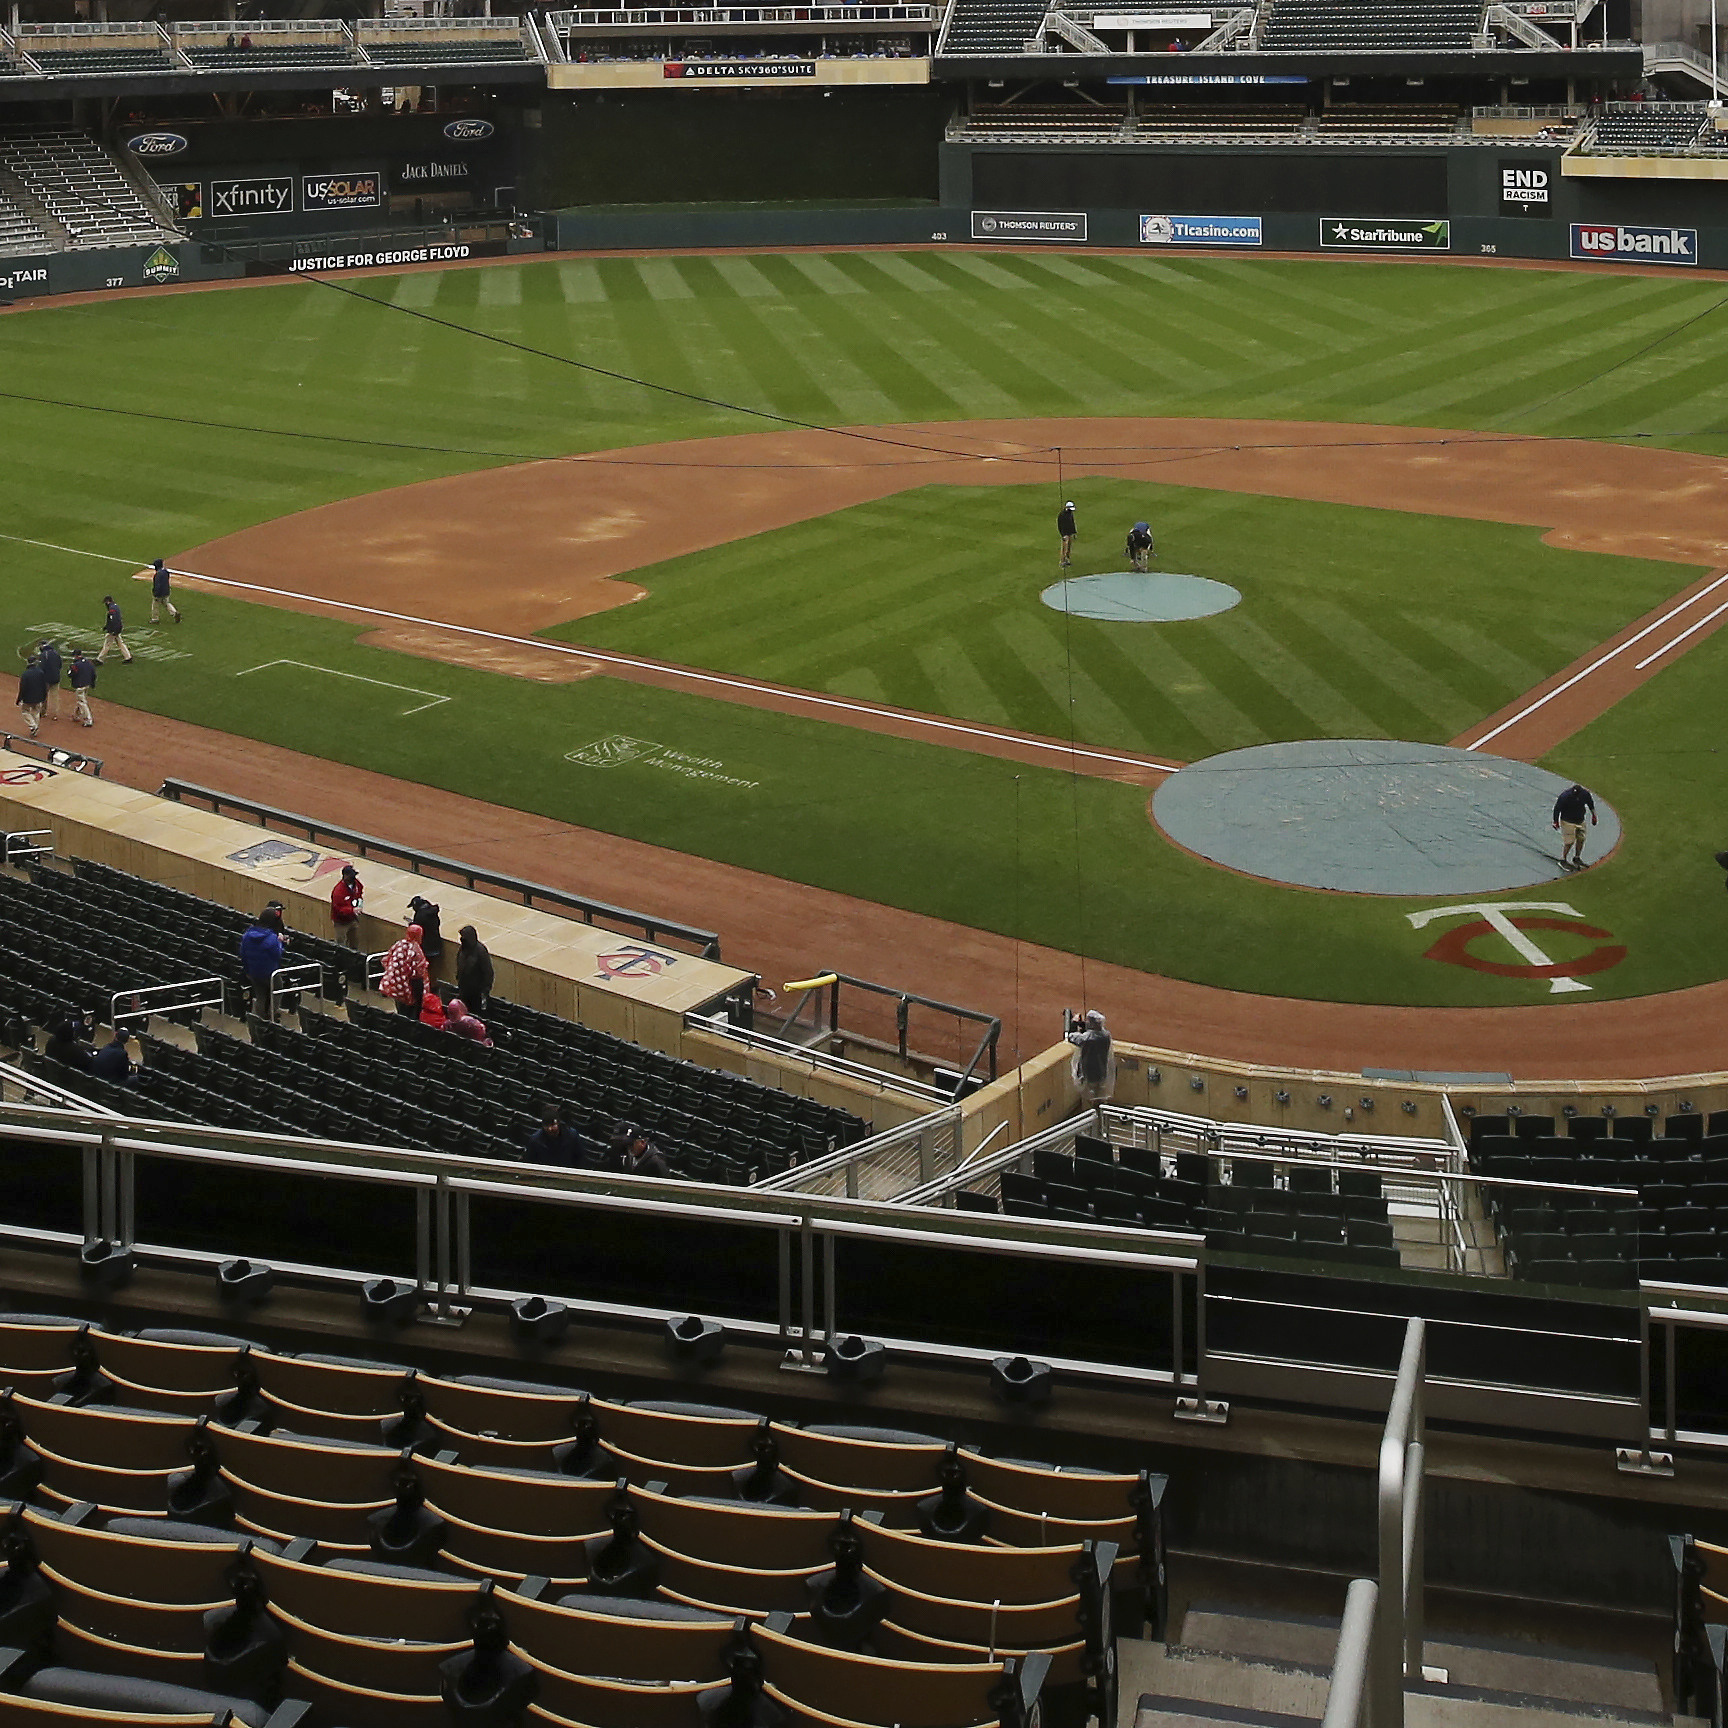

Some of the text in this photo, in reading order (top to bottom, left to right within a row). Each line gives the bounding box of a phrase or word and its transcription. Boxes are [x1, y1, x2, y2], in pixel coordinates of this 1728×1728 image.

[697, 65, 735, 76] DELTA
[1146, 75, 1265, 84] TREASURE ISLAND COVE
[453, 122, 485, 138] Ford
[139, 134, 176, 153] Ford
[402, 161, 468, 179] JACK DANIEL'S
[1503, 170, 1548, 188] END
[216, 184, 289, 212] xfinity
[1506, 190, 1545, 200] RACISM
[999, 221, 1038, 230] THOMSON
[1175, 223, 1259, 238] TIcasino.com
[931, 232, 948, 241] 403
[1350, 228, 1424, 244] StarTribune
[289, 246, 470, 271] JUSTICE FOR GEORGE FLOYD
[144, 266, 180, 277] SUMMIT
[106, 277, 124, 287] 377
[663, 749, 724, 770] Wealth
[643, 757, 760, 790] Management
